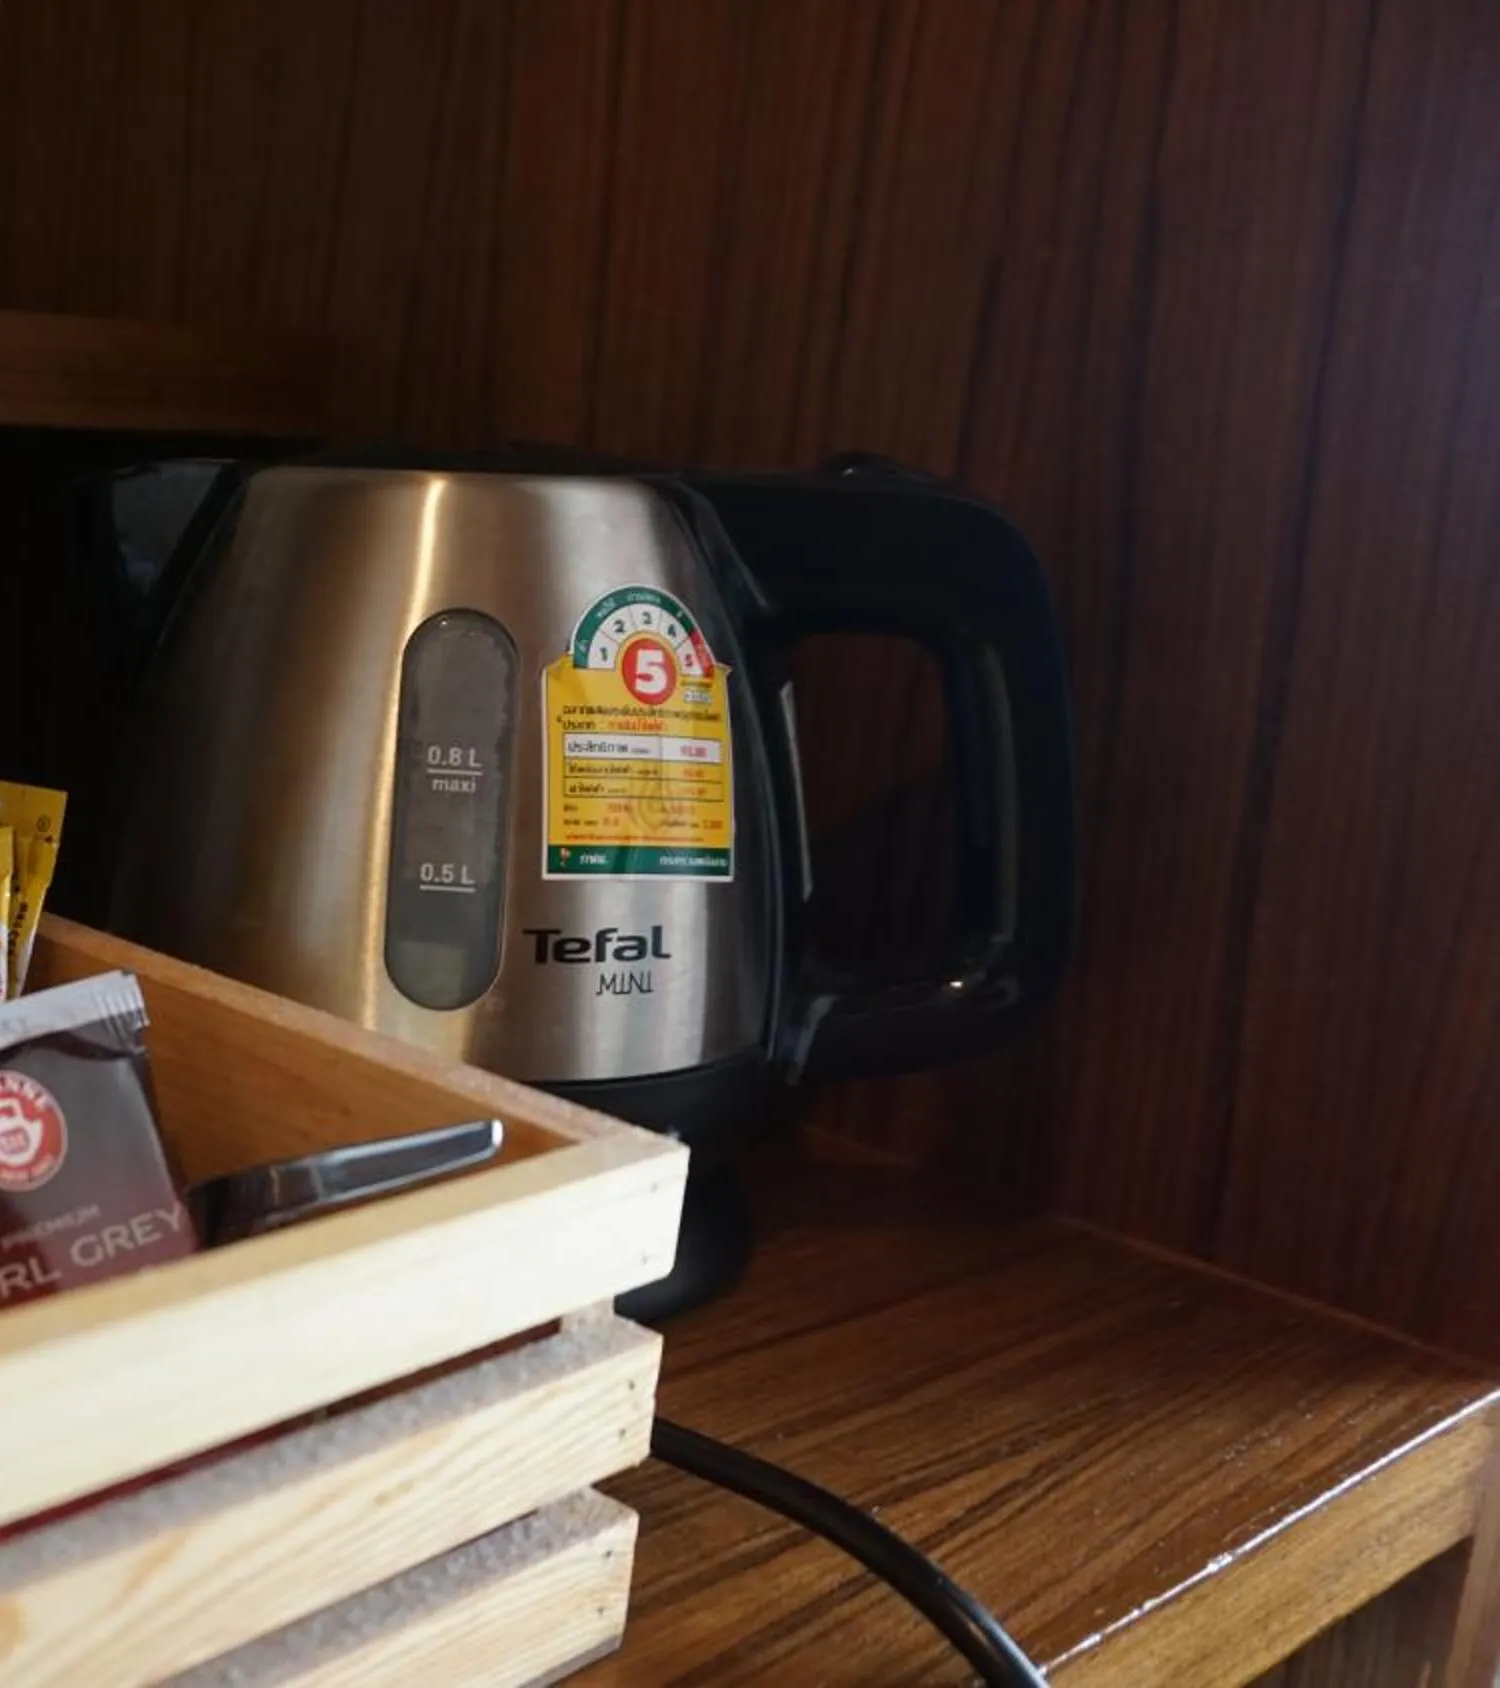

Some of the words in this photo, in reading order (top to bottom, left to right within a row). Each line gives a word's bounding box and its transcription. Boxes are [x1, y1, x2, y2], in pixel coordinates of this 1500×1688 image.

[613, 619, 626, 634] 2
[634, 648, 669, 695] 5
[427, 745, 462, 767] 0.8
[468, 747, 483, 768] L
[431, 776, 477, 793] maxi
[420, 862, 455, 884] 0.5
[461, 865, 476, 885] L
[522, 924, 672, 965] Tefal
[596, 971, 655, 996] MINI
[68, 1203, 184, 1268] GREY
